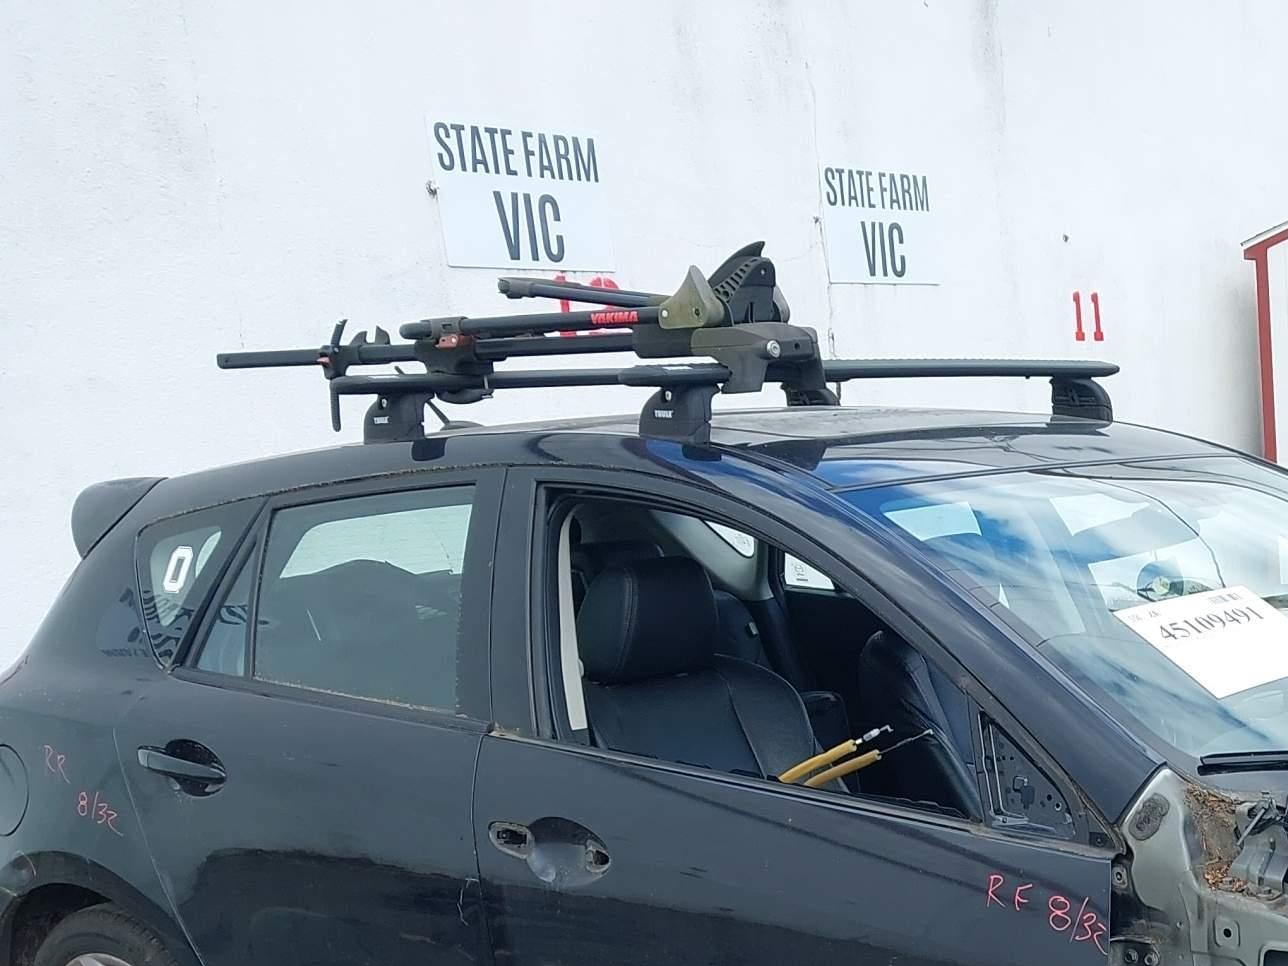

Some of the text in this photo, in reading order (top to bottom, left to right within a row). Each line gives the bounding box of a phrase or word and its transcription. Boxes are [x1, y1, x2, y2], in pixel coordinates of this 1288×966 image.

[433, 122, 599, 183] STATE FARM
[824, 166, 930, 212] STATE FARM
[492, 190, 565, 263] VIC
[860, 220, 906, 278] VIC
[591, 311, 639, 325] YAKIMA
[1072, 291, 1104, 341] 11
